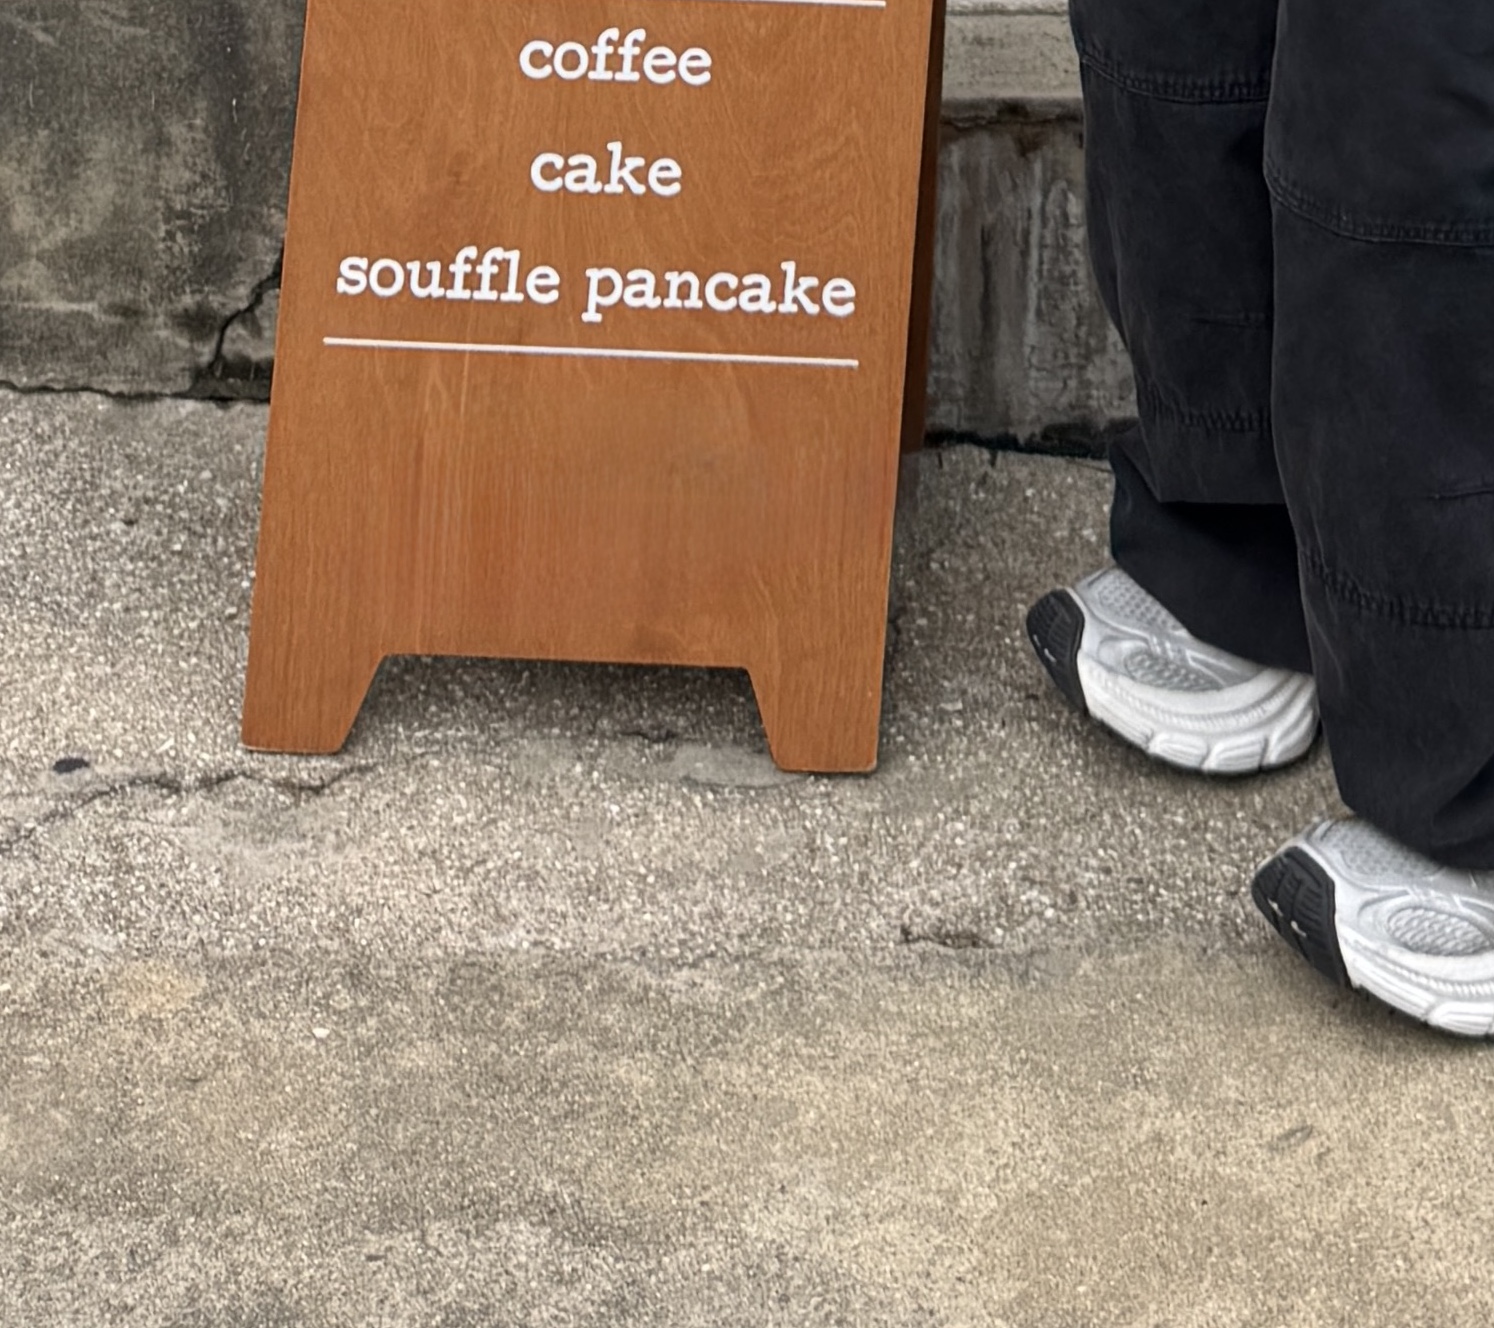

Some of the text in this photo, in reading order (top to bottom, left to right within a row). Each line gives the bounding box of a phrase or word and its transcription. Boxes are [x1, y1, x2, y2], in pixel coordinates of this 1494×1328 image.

[519, 27, 712, 86] coffee
[530, 141, 682, 196] cake
[336, 245, 856, 323] souffle pancake
